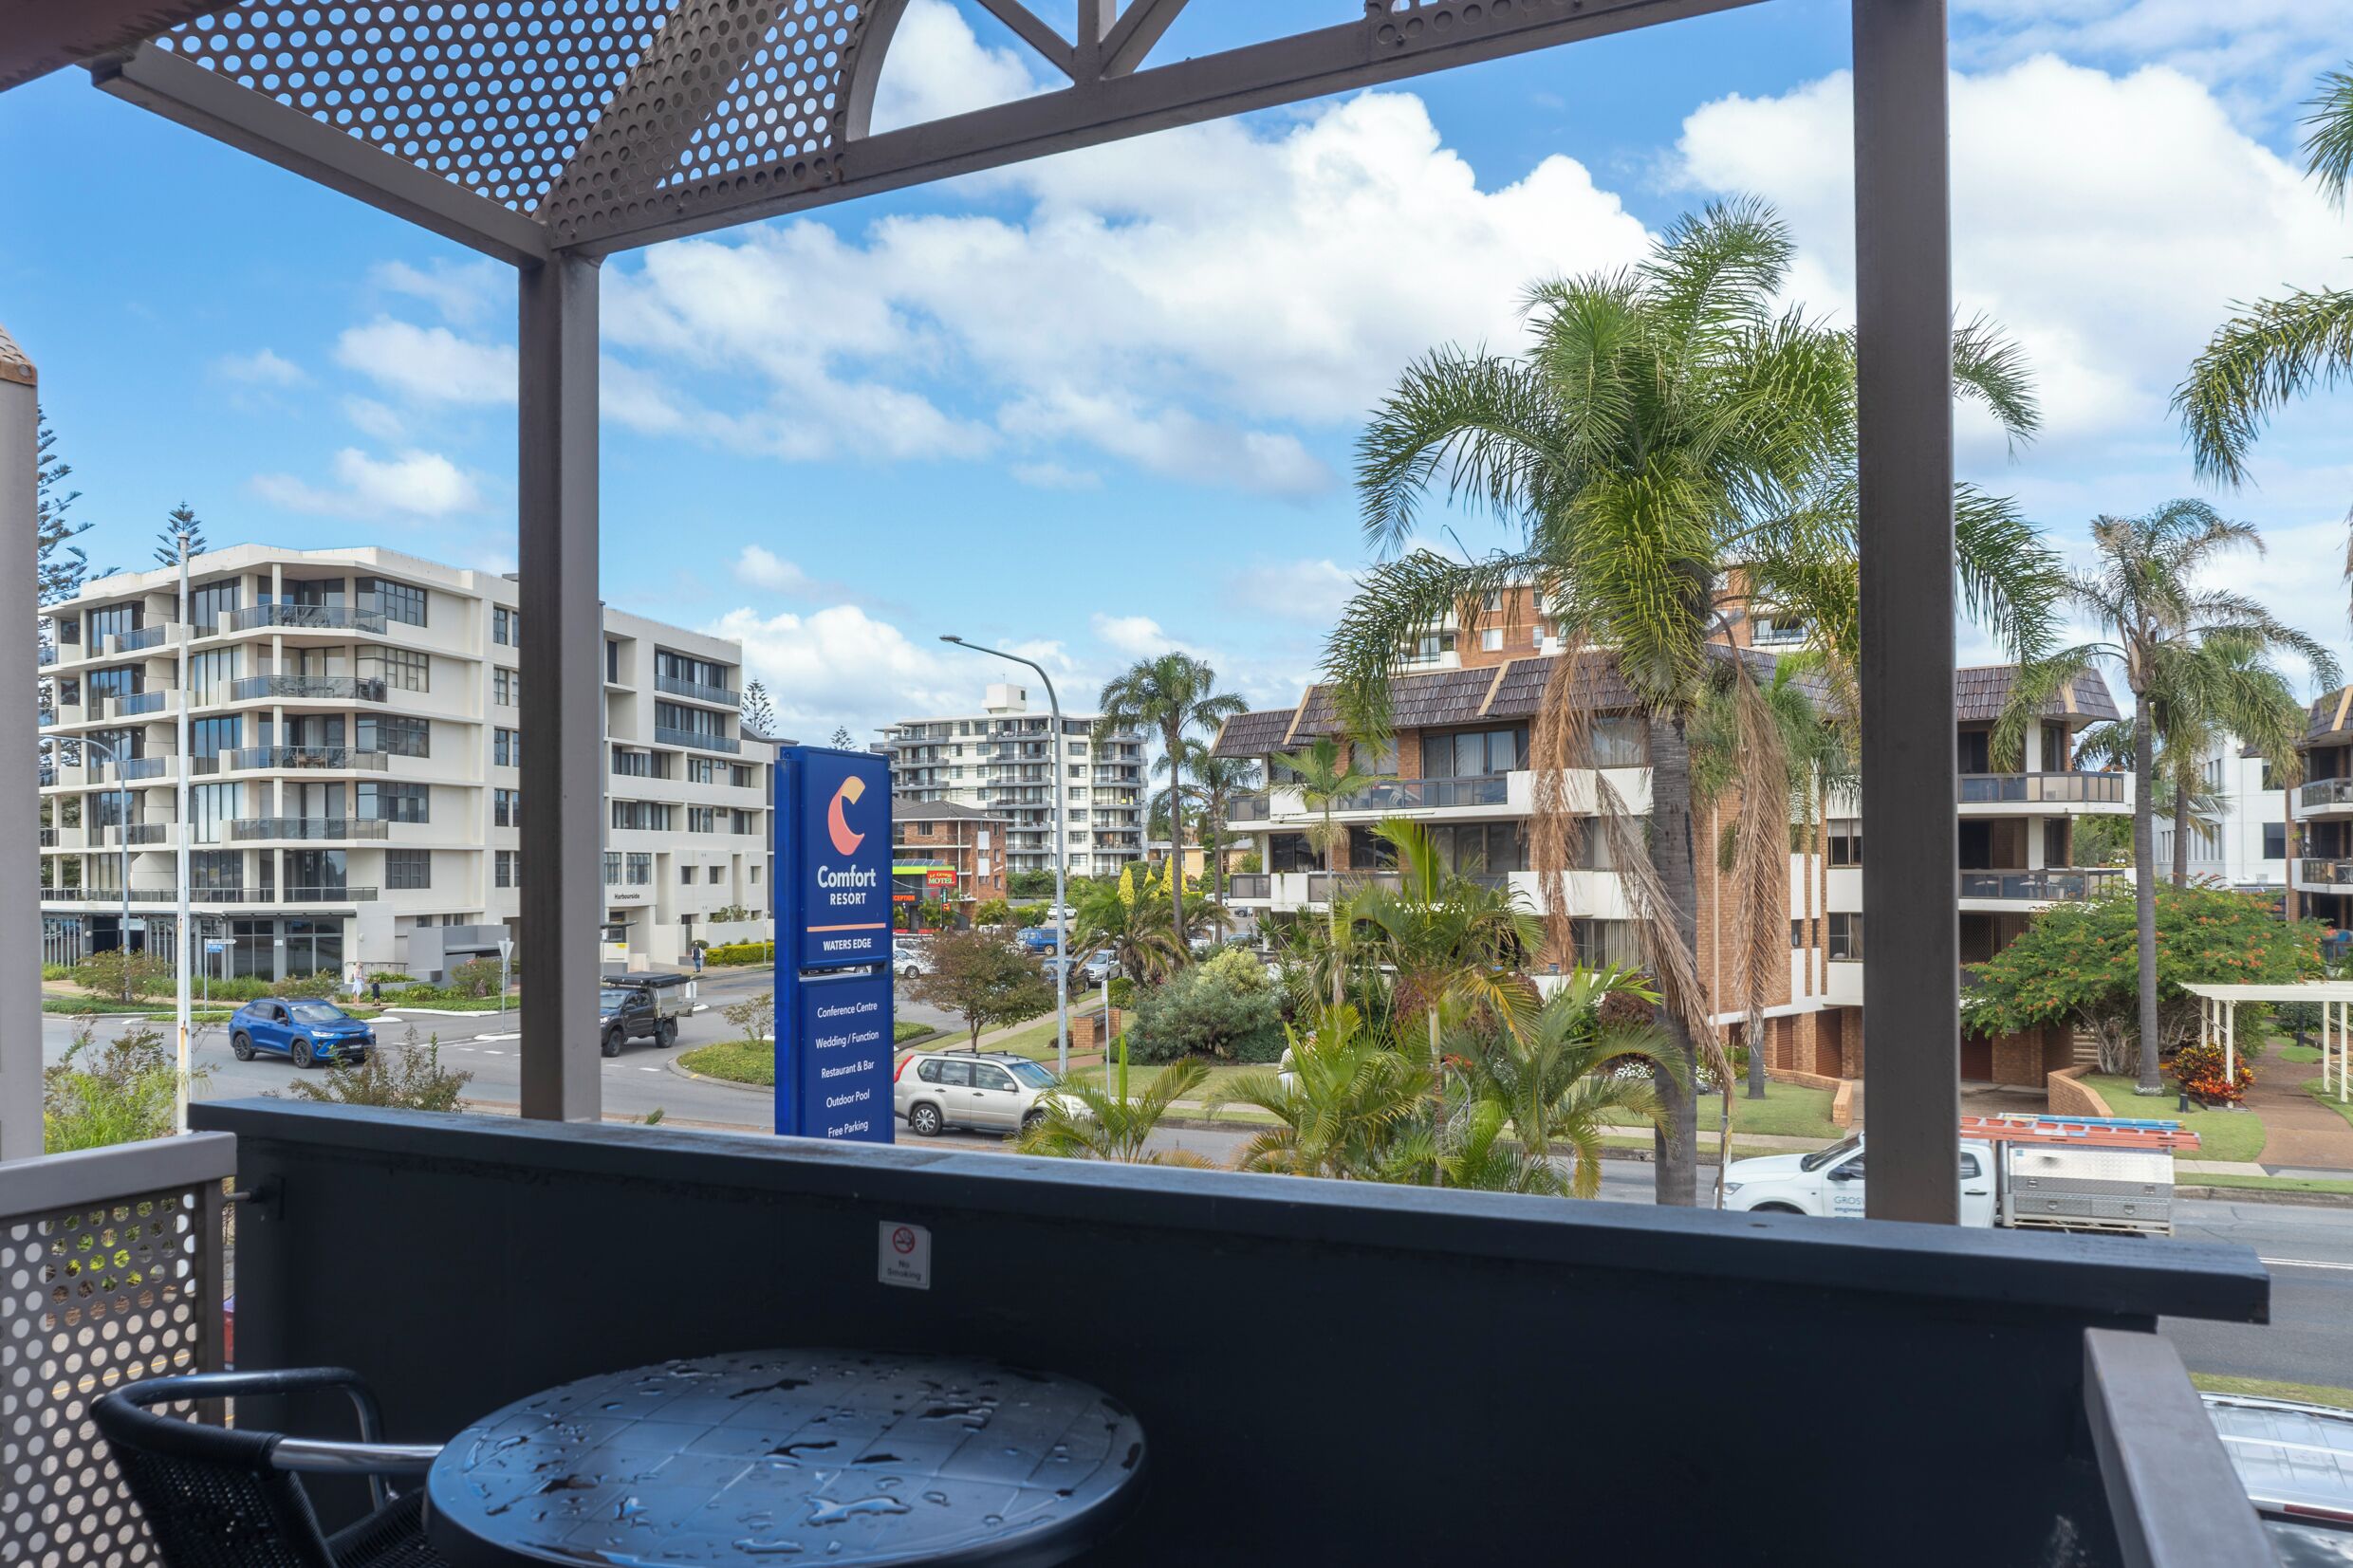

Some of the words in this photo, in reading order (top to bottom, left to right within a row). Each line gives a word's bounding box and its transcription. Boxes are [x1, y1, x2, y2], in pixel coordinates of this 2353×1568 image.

[817, 864, 877, 888] Comfort
[829, 893, 867, 905] RESORT
[823, 939, 852, 951] WATERS
[852, 938, 872, 949] EDGE
[817, 1005, 856, 1018] Conference
[856, 1002, 878, 1013] Centre
[815, 1035, 846, 1049] Wedding
[851, 1030, 880, 1043] Function
[821, 1063, 857, 1079] Restaurant
[857, 1061, 862, 1071] &
[862, 1060, 875, 1071] Bar
[825, 1094, 855, 1108] Outdoor
[855, 1088, 870, 1101] Pool
[827, 1126, 843, 1138] Free
[843, 1120, 869, 1134] Parking
[1833, 1196, 1865, 1205] GROS
[899, 1260, 910, 1268] No
[888, 1267, 921, 1281] Smoking
